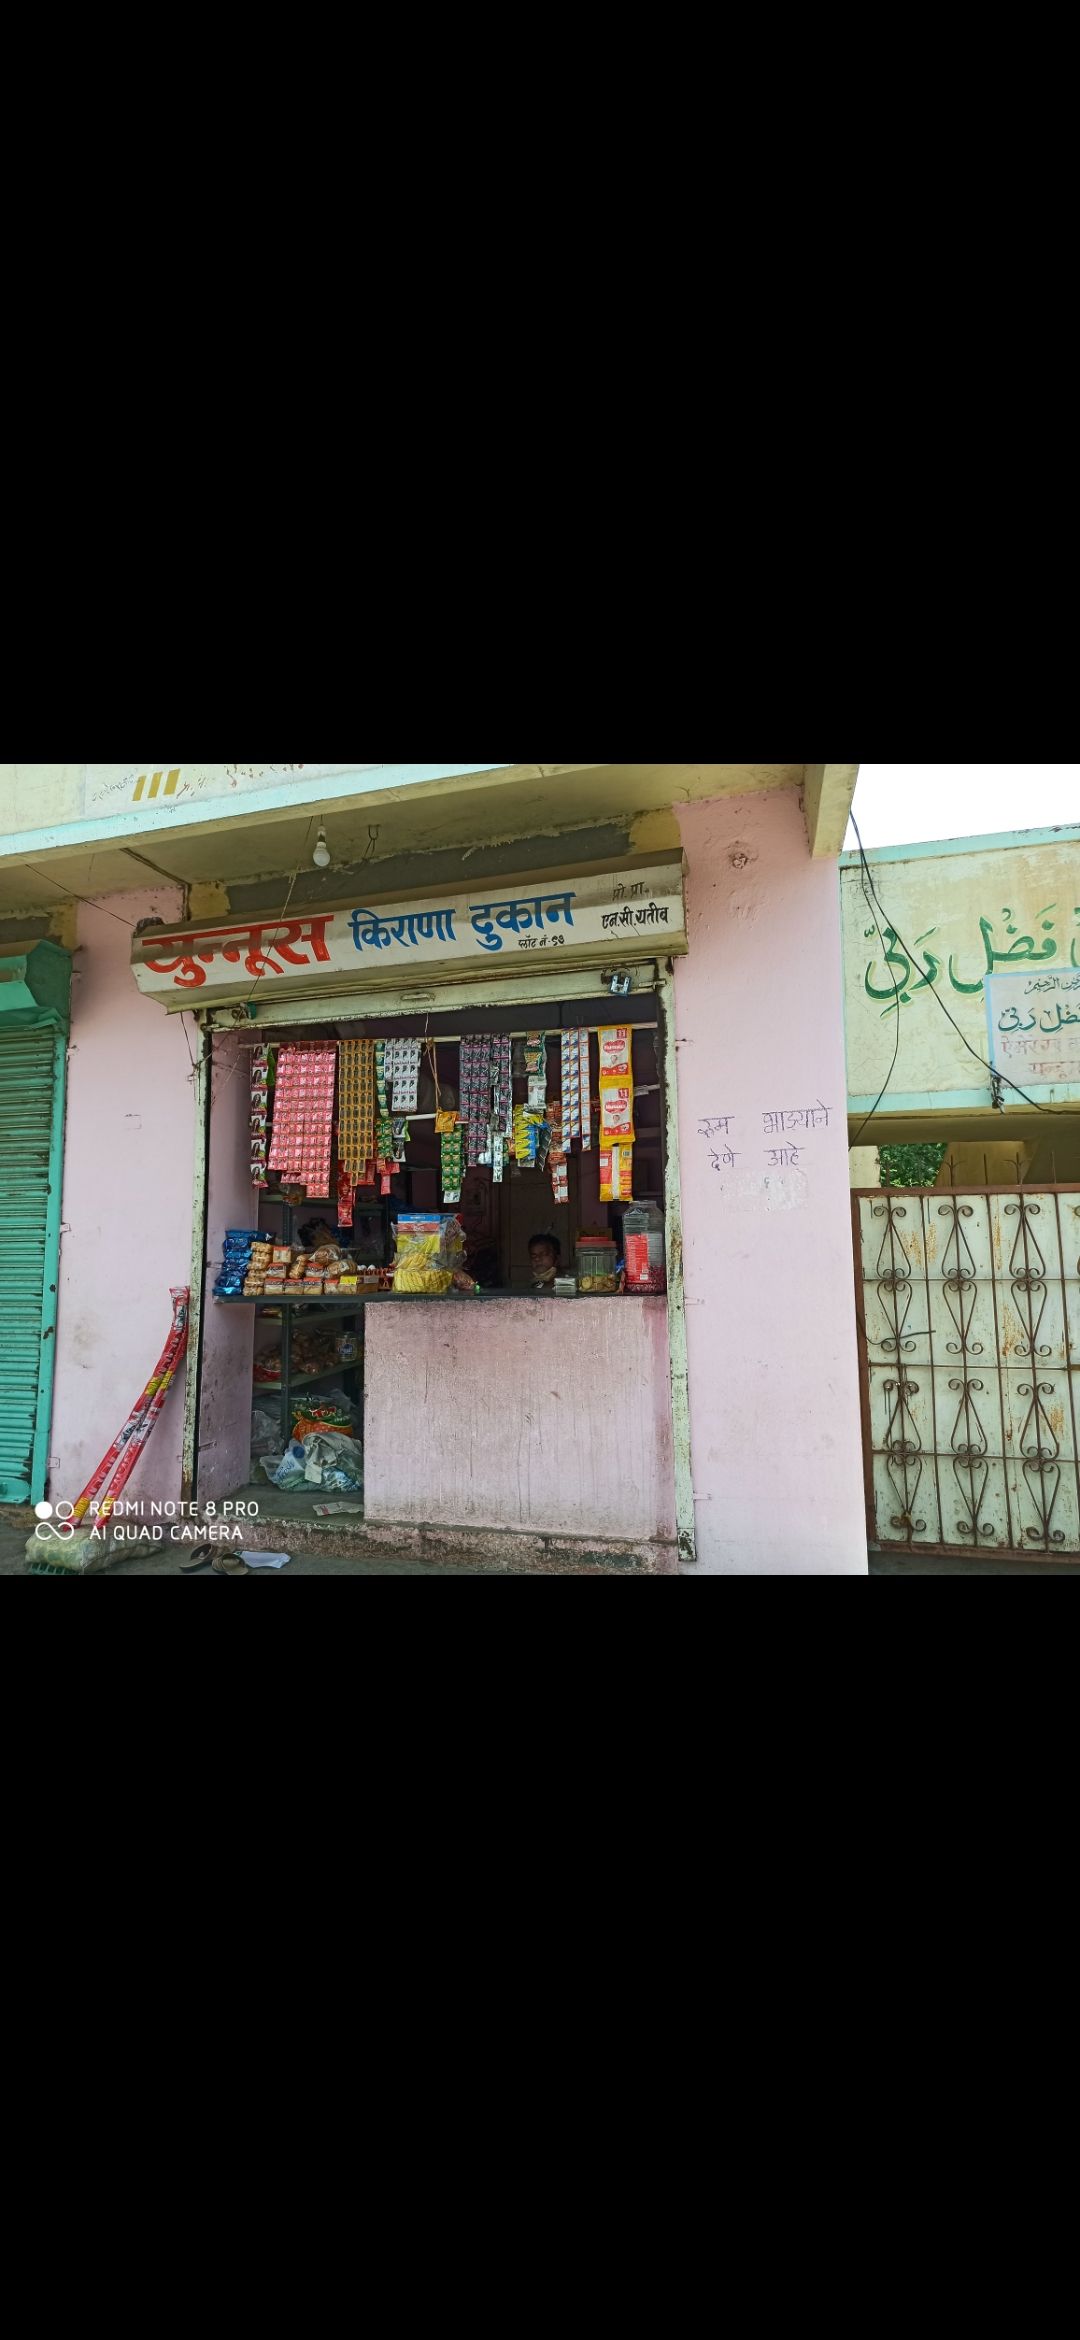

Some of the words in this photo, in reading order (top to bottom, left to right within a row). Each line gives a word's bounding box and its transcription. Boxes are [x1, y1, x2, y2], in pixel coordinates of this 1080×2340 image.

[142, 914, 335, 988] युन्नूस
[347, 908, 456, 951] किराणा
[469, 891, 577, 951] दुकान
[763, 1141, 806, 1166] आहे
